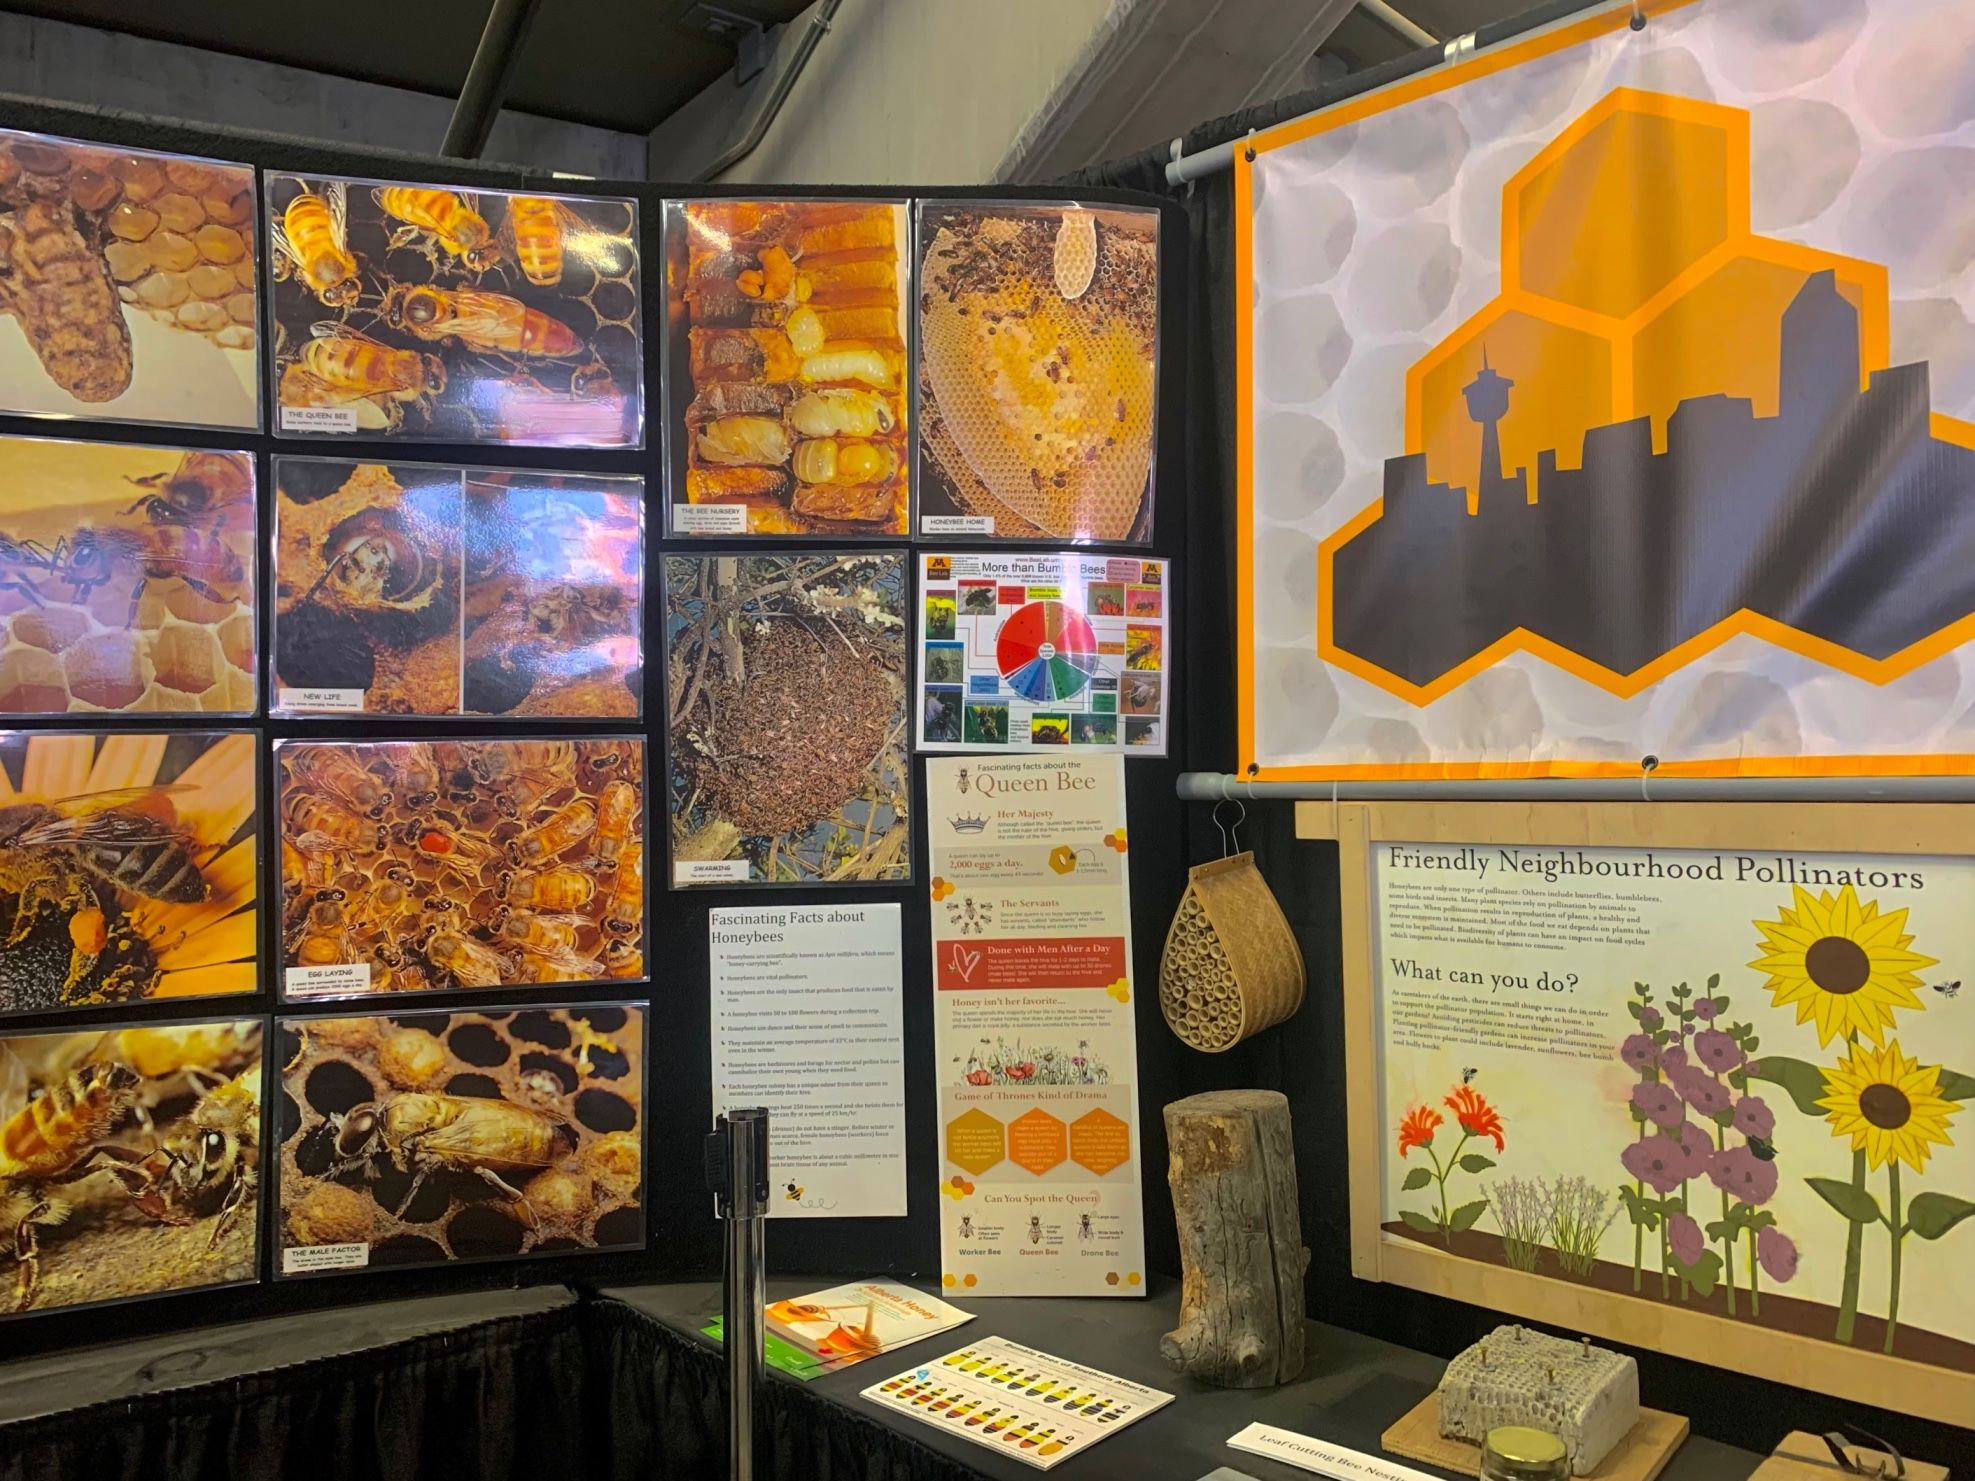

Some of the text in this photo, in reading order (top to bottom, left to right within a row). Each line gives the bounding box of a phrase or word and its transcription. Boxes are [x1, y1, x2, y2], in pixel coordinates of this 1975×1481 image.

[982, 563, 1008, 572] More
[1012, 563, 1034, 572] than
[1080, 564, 1105, 574] Bees
[978, 764, 1021, 772] Fascinating
[975, 772, 1096, 798] Queen Bee
[998, 810, 1053, 819] Her Majesty
[950, 860, 972, 868] 2,000
[974, 861, 995, 870] eggs
[1005, 859, 1023, 868] day.
[1389, 846, 1924, 889] Friendly Neighbourhood Pollinators
[1434, 884, 1447, 892] only
[1462, 886, 1475, 894] type
[1485, 887, 1520, 895] pollinator.
[1522, 889, 1545, 897] Others
[1548, 890, 1573, 898] include
[1575, 891, 1614, 900] butterflies,
[1616, 893, 1662, 903] bumblebees,
[1461, 896, 1478, 904] Many
[1480, 897, 1496, 905] plant
[1548, 901, 1586, 910] pollination
[1589, 902, 1597, 911] by
[711, 911, 865, 926] Fascinating Facts about
[1423, 904, 1441, 912] When
[1512, 910, 1556, 919] reproduction
[1568, 913, 1591, 921] plants,
[1599, 915, 1625, 924] healthy
[1451, 916, 1488, 924] maintained.
[1569, 923, 1599, 932] depends
[1612, 926, 1634, 934] plants
[712, 931, 783, 945] Honeybees
[988, 946, 1012, 954] Done
[1038, 945, 1058, 953] Men
[1093, 944, 1110, 954] Day
[1391, 958, 1579, 993] What can you do?
[952, 998, 981, 1007] Honey
[1022, 997, 1066, 1005] favorite...
[955, 1092, 981, 1100] Game
[984, 1092, 993, 1100] of
[985, 1195, 1003, 1203] Can
[1004, 1195, 1022, 1203] You
[1024, 1195, 1046, 1205] Spot
[1048, 1194, 1063, 1202] the
[865, 1286, 902, 1302] Alberta
[902, 1300, 938, 1319] Honey
[1038, 1354, 1059, 1363] Bees
[1072, 1365, 1113, 1382] Southern
[1114, 1380, 1149, 1394] Alberta
[1260, 1435, 1405, 1481] Leaf Cutting Bee Nesti
